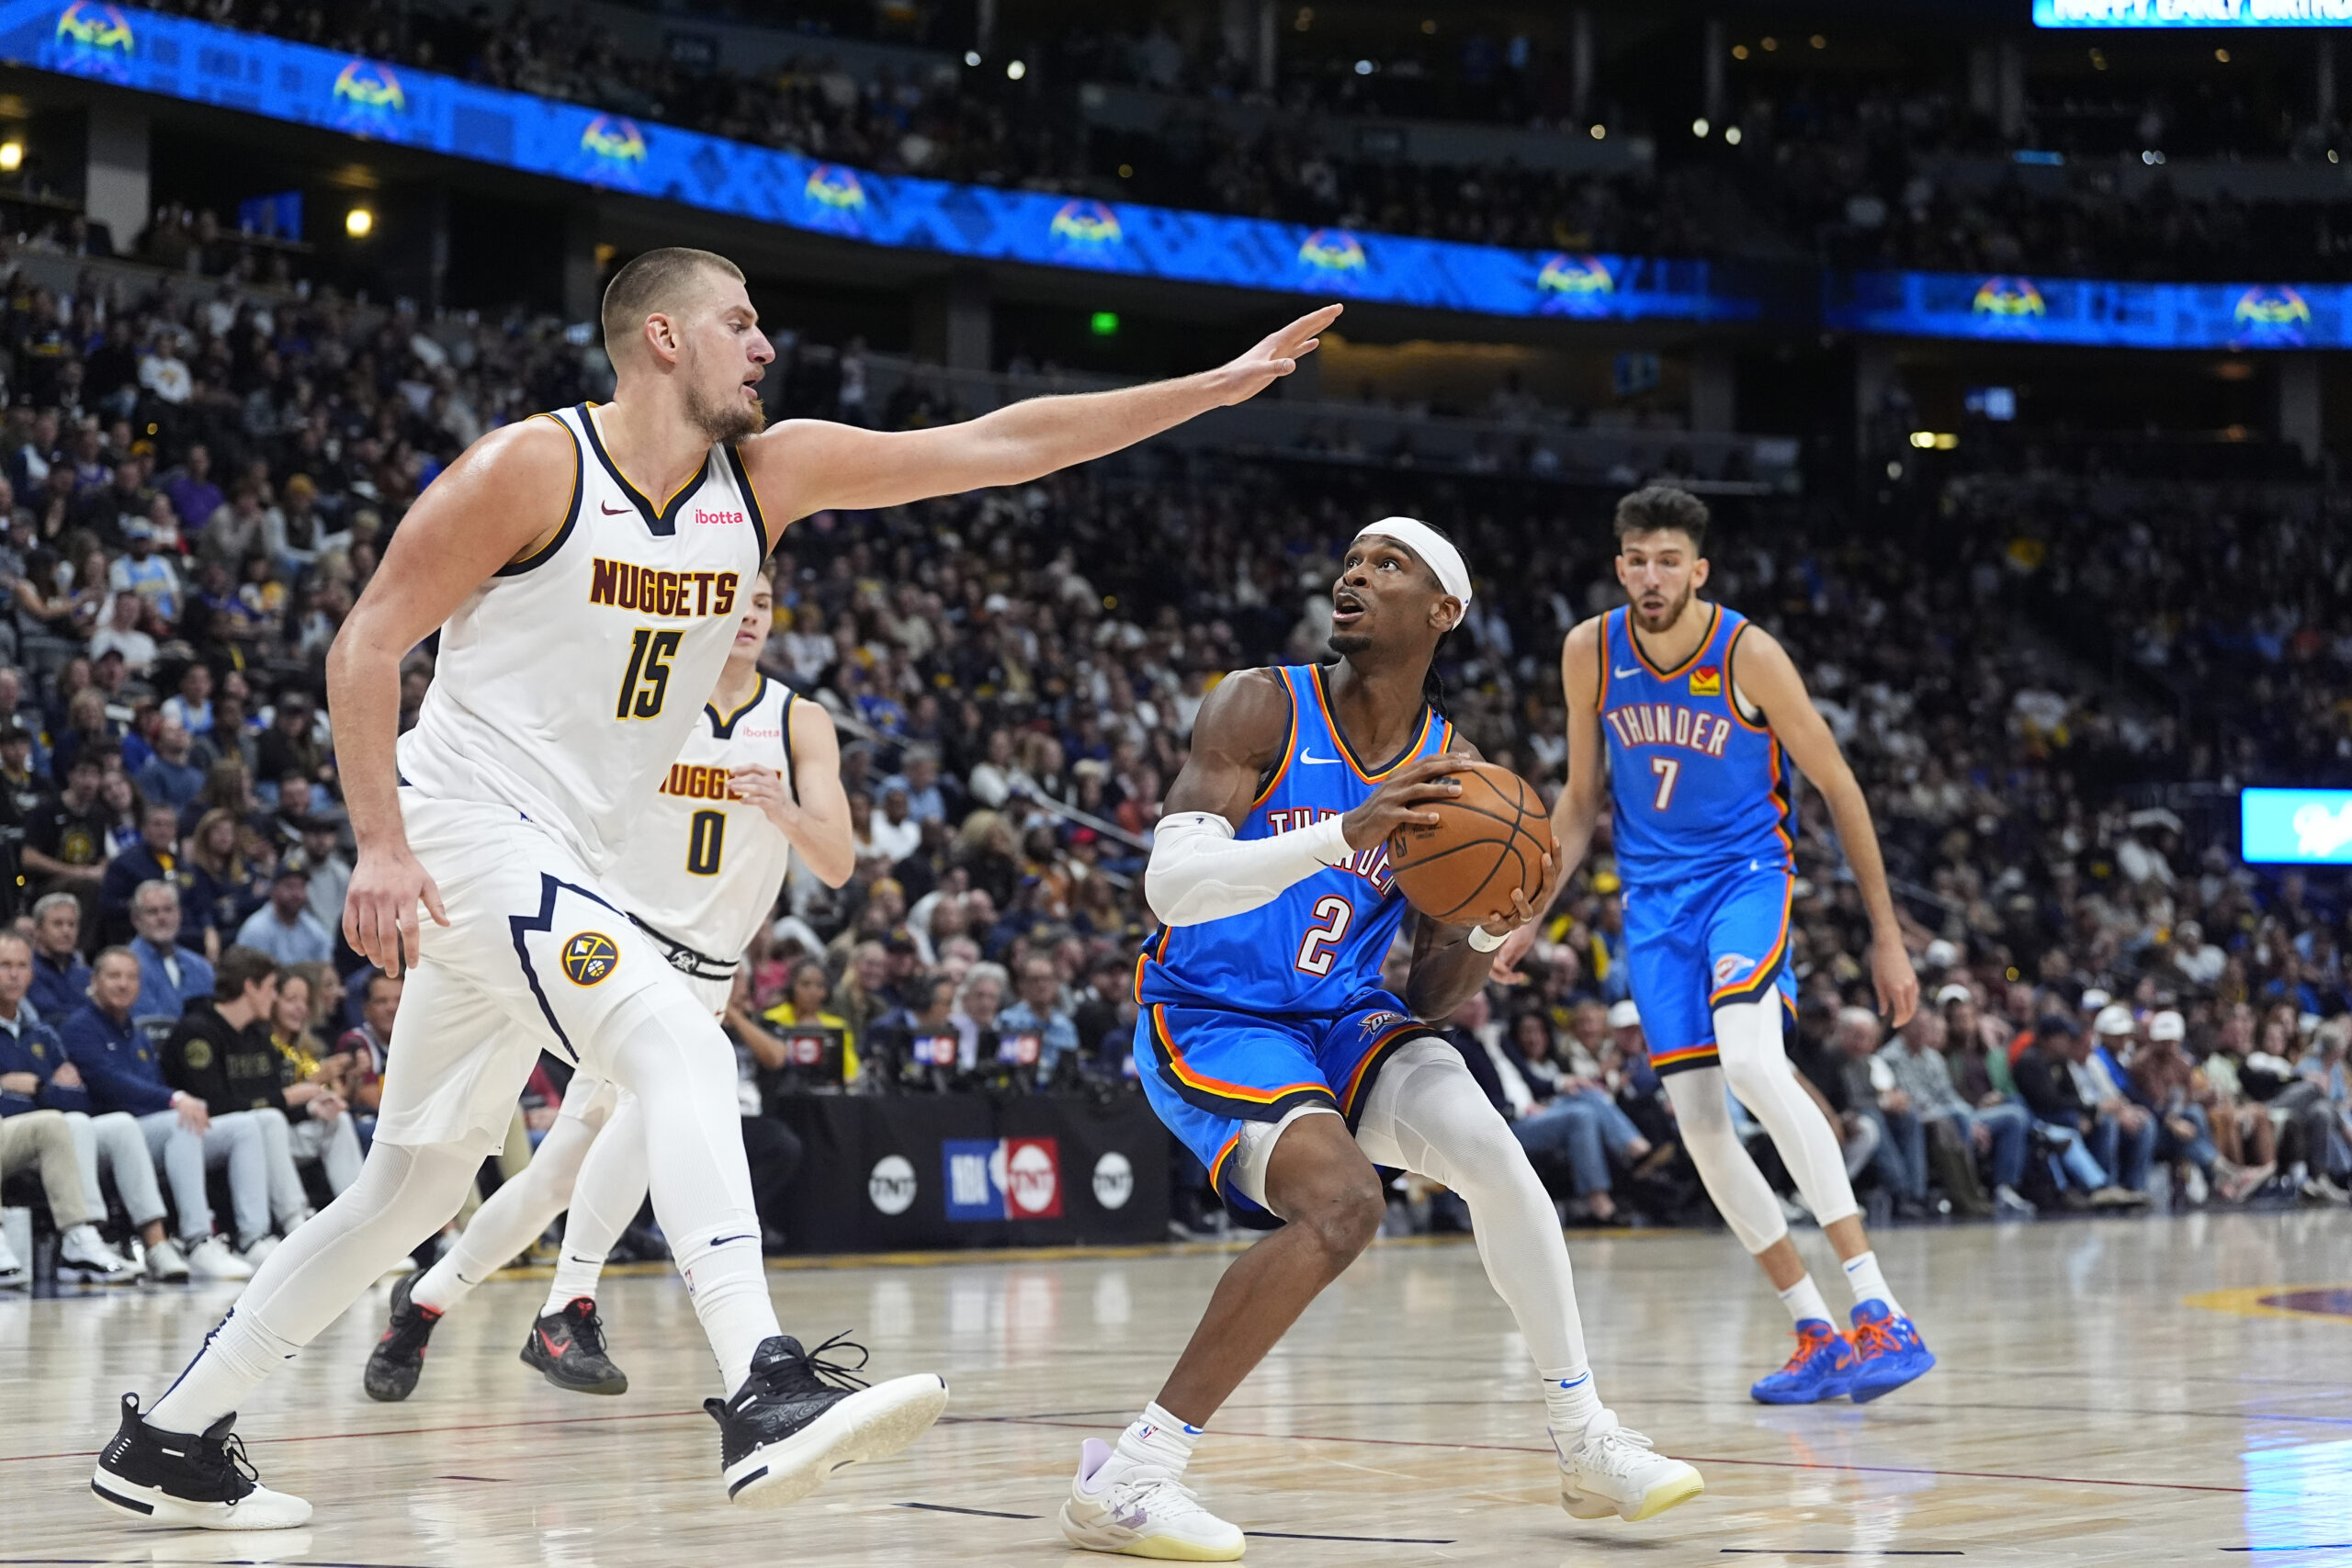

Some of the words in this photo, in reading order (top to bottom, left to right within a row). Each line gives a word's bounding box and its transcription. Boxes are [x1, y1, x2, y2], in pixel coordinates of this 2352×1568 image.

[695, 510, 742, 525] ibotta
[589, 557, 739, 617] NUGGETS
[616, 627, 685, 720] 15
[743, 727, 780, 738] ibotta
[1606, 704, 1731, 757] THUNDER
[1651, 756, 1679, 811] 7
[686, 807, 727, 876] 0
[1294, 894, 1354, 978] 2
